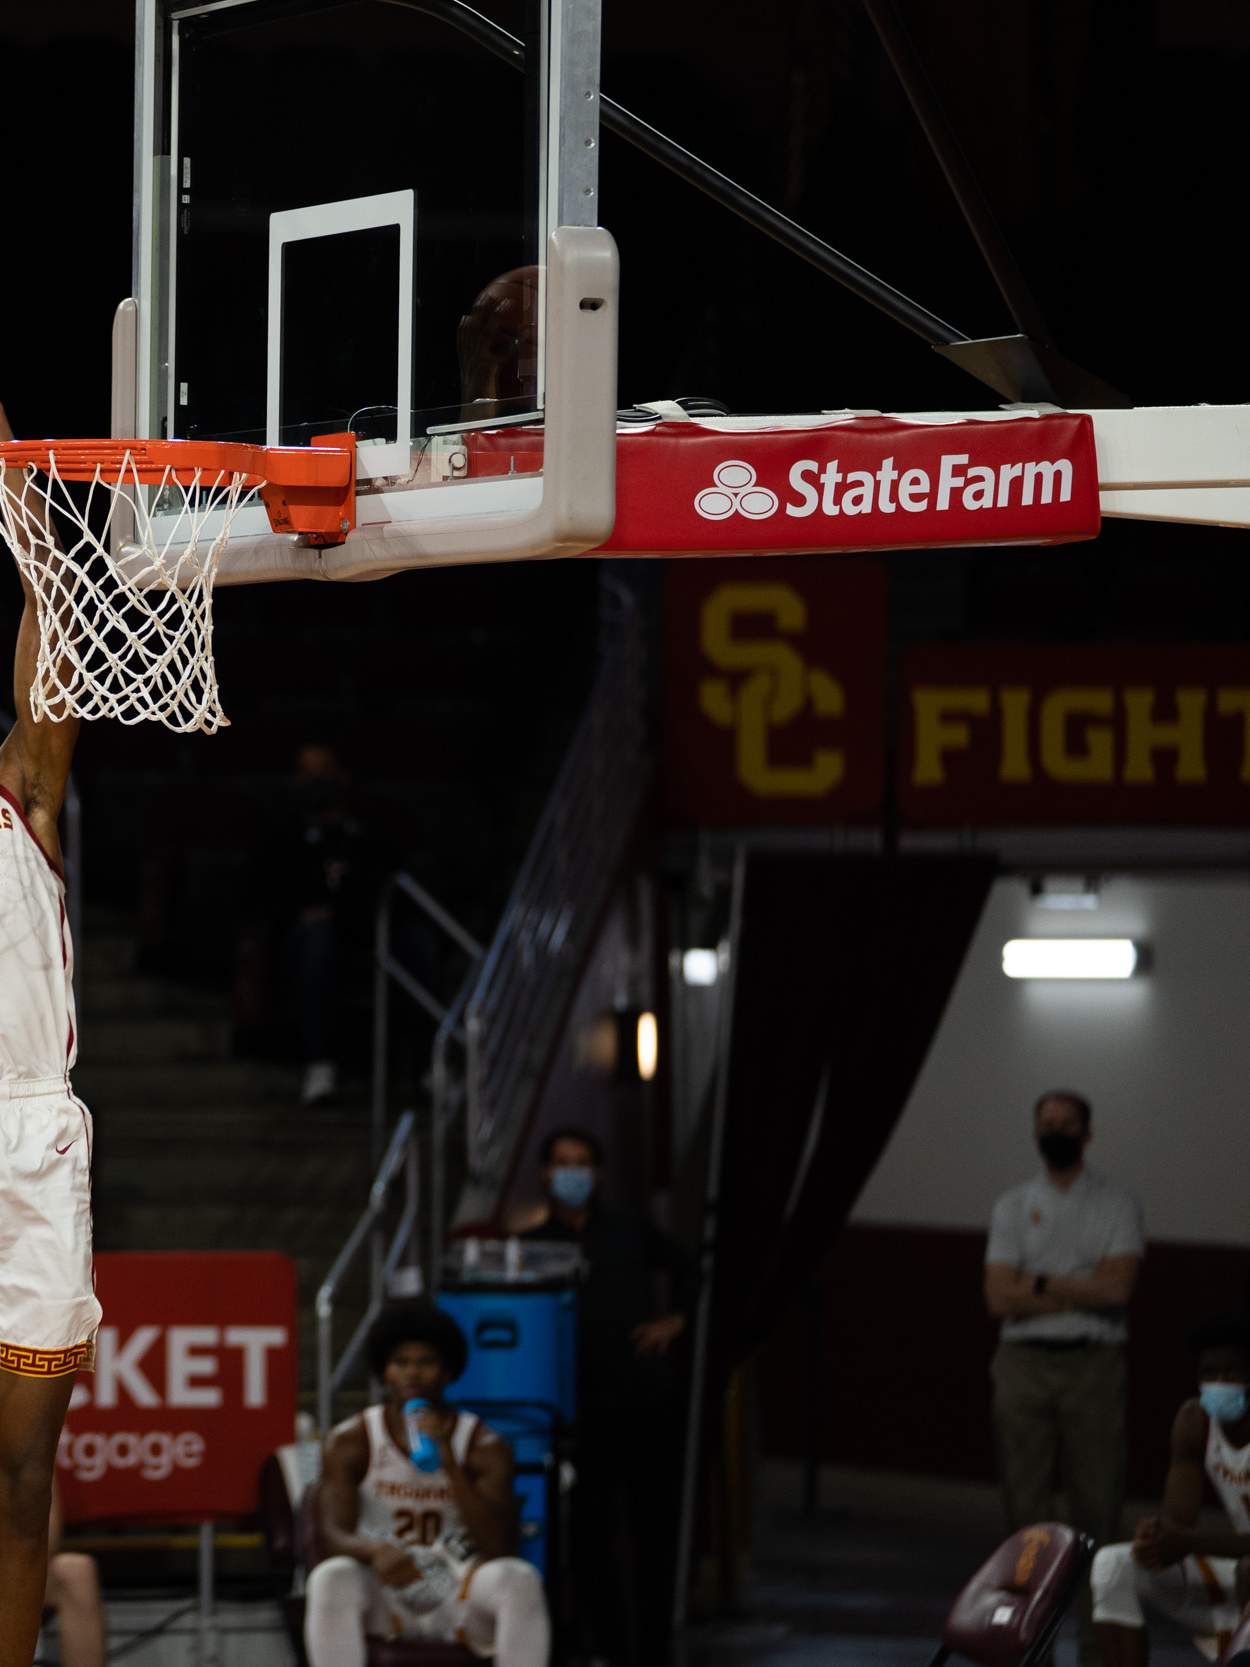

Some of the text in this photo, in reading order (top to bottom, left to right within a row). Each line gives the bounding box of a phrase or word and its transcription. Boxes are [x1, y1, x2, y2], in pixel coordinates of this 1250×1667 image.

[786, 453, 1074, 518] State Farm
[699, 578, 845, 798] SC
[69, 1325, 288, 1410] KET
[394, 1509, 442, 1546] 20
